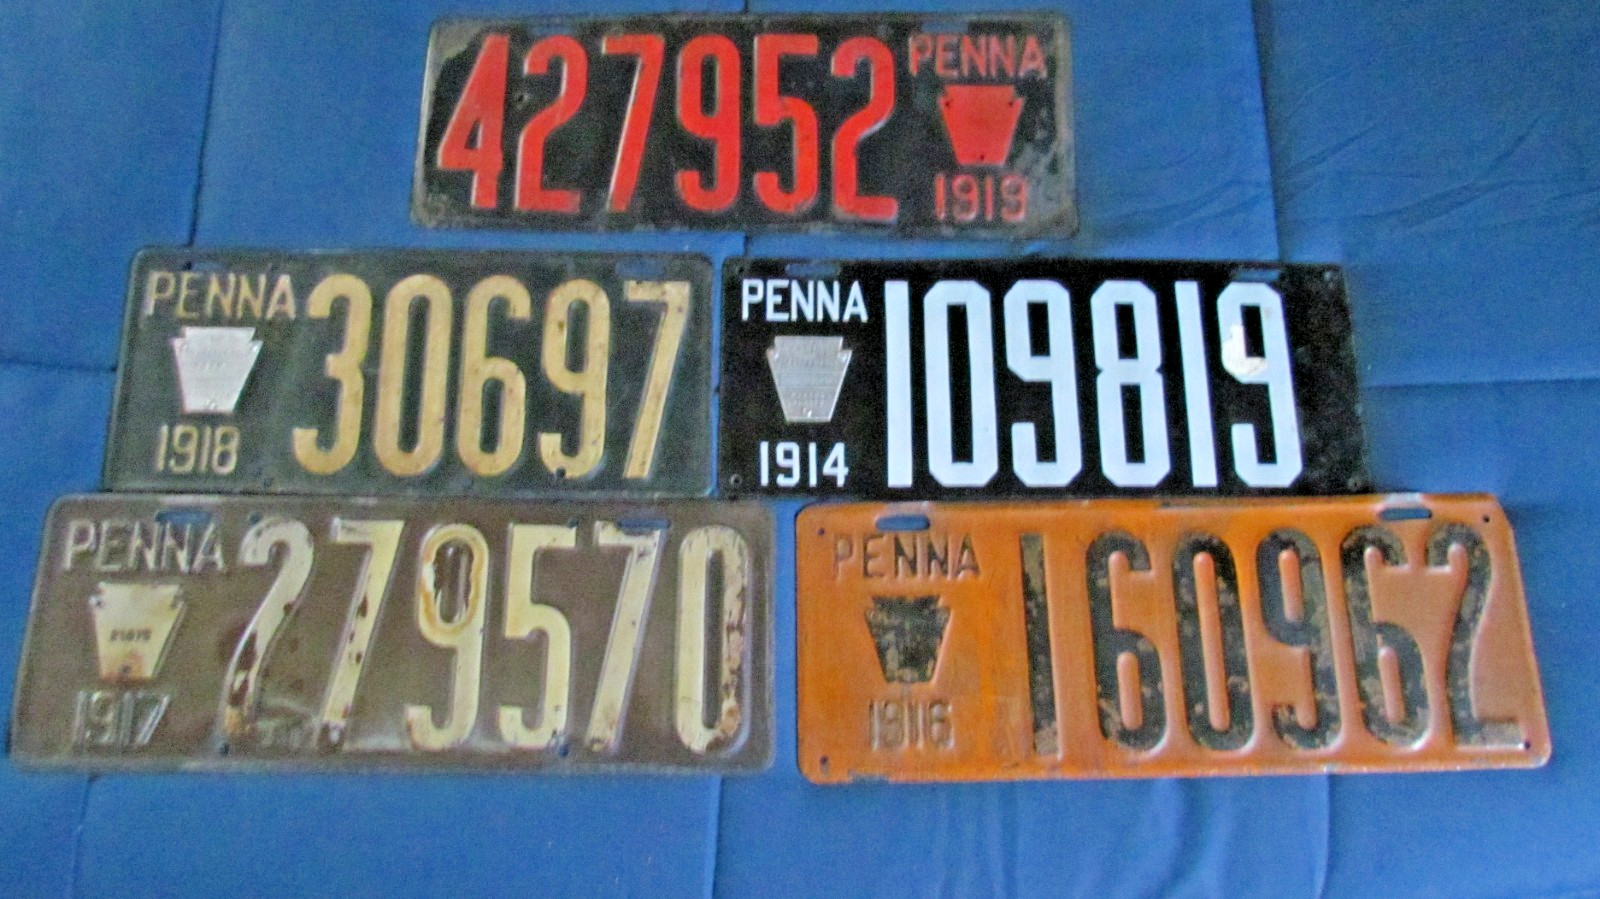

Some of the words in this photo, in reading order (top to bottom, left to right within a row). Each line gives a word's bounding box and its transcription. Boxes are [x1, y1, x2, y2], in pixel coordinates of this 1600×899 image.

[907, 33, 1050, 78] PENNA
[436, 33, 898, 223] 427952
[934, 175, 1029, 223] 1919
[144, 271, 297, 320] PENNA
[741, 278, 868, 322] PENNA
[293, 274, 692, 480] 30697
[884, 279, 1301, 488] 109819
[155, 424, 240, 475] 1918
[758, 441, 849, 488] 1914
[63, 518, 227, 573] PENNA
[832, 532, 983, 580] PENNA
[221, 516, 752, 753] 279570
[1018, 521, 1529, 757] 160962
[73, 690, 171, 745] 1917
[867, 698, 955, 750] 1916
